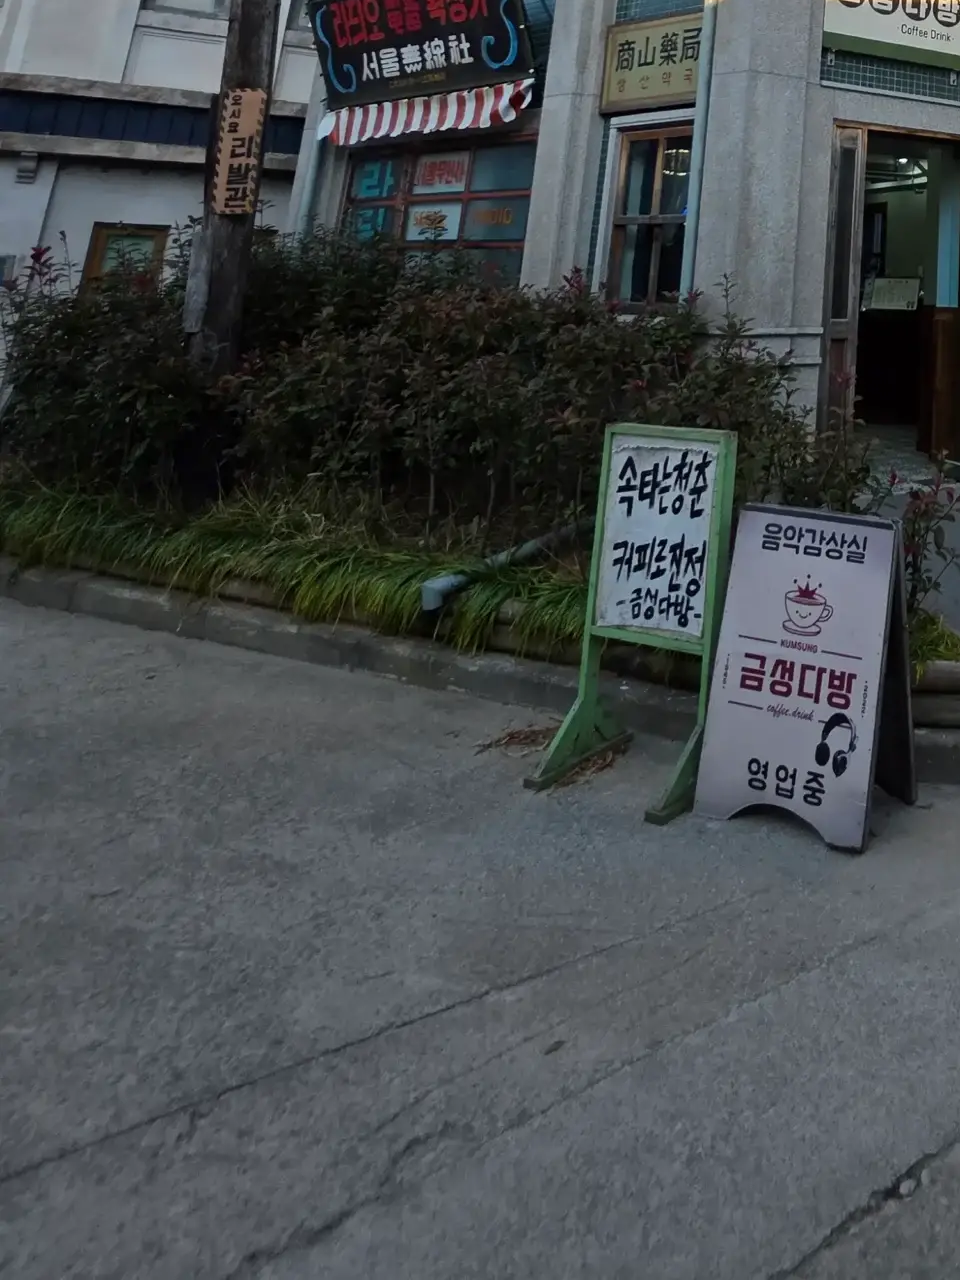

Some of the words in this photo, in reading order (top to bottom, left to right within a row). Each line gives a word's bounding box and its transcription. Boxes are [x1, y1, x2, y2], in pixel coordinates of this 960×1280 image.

[901, 24, 928, 38] Coffee
[930, 30, 951, 42] Drink
[761, 522, 867, 564] 음악감상실
[780, 639, 818, 654] KUMSUNG
[747, 756, 825, 808] 영업중
